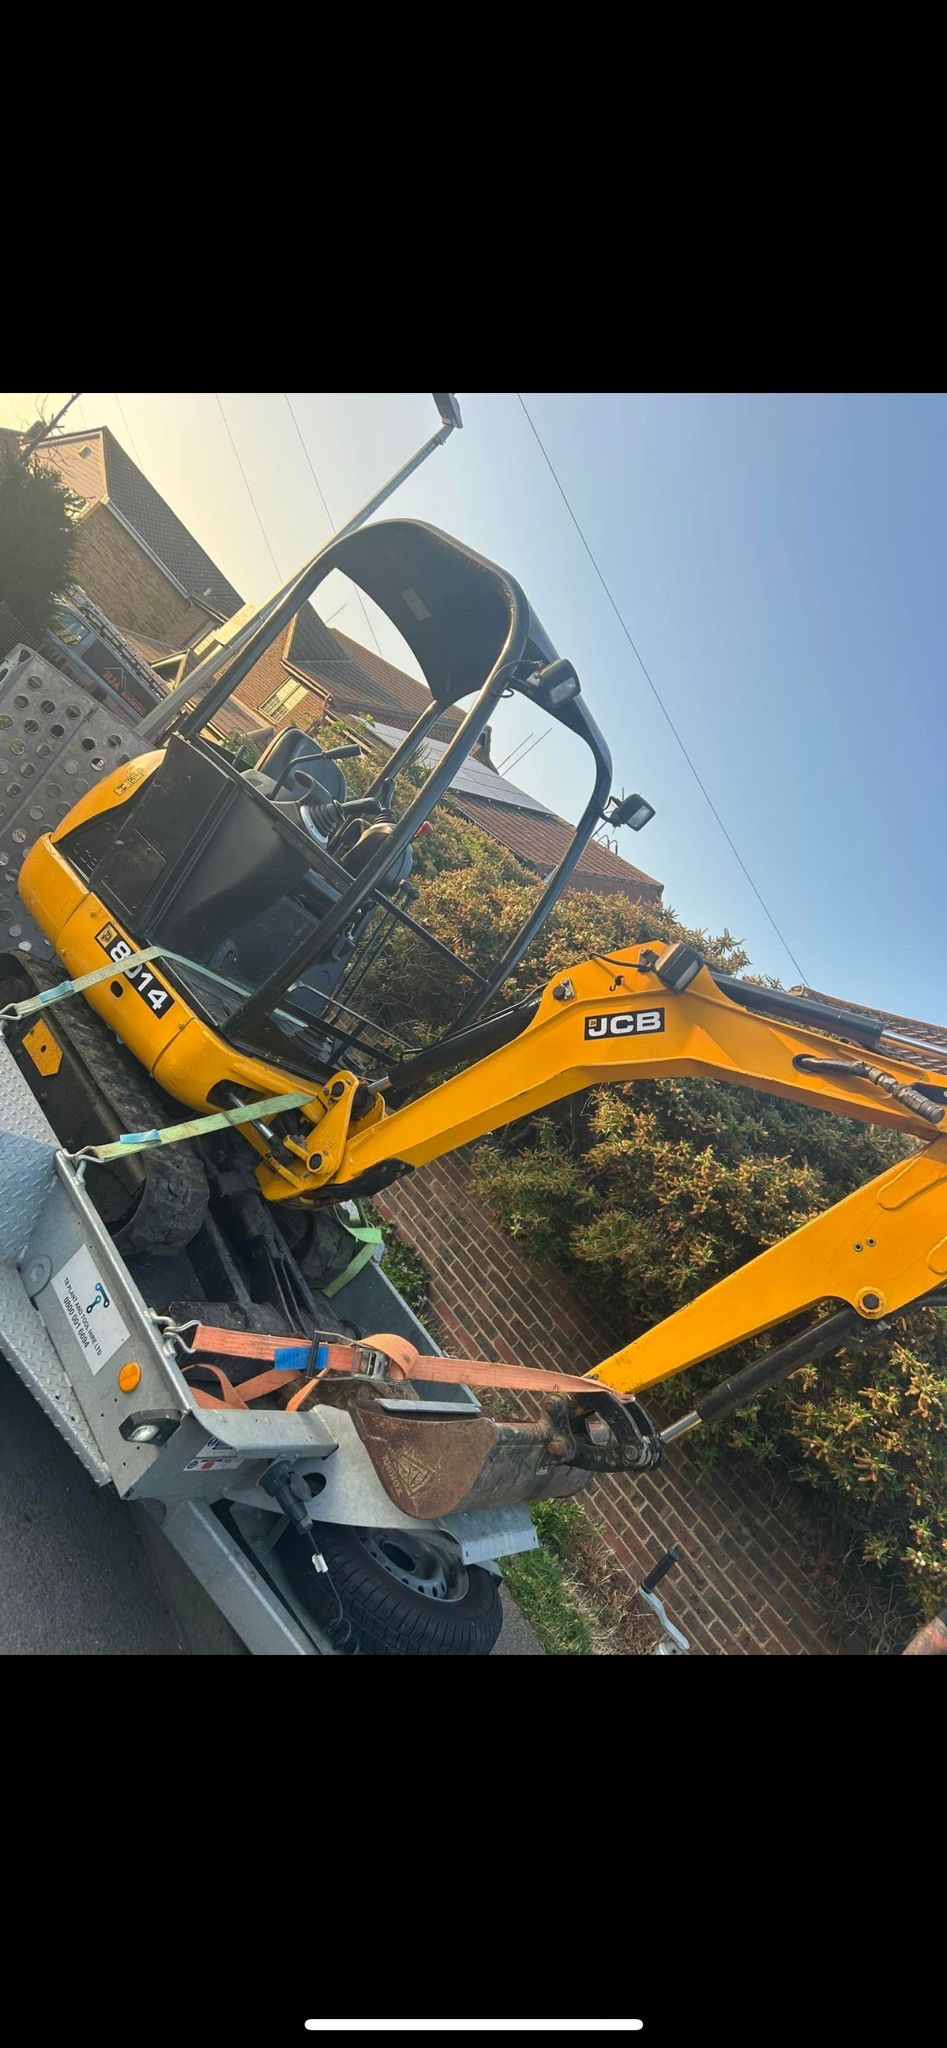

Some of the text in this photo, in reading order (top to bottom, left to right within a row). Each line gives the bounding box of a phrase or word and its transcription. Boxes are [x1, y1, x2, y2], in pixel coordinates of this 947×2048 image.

[588, 1011, 661, 1037] JCB
[63, 1297, 90, 1349] 0800 001 6694
[67, 1284, 78, 1303] PLANT
[74, 1302, 83, 1315] AND
[80, 1313, 90, 1331] TOOL
[87, 1329, 98, 1345] HIRE
[94, 1343, 103, 1356] LTD
